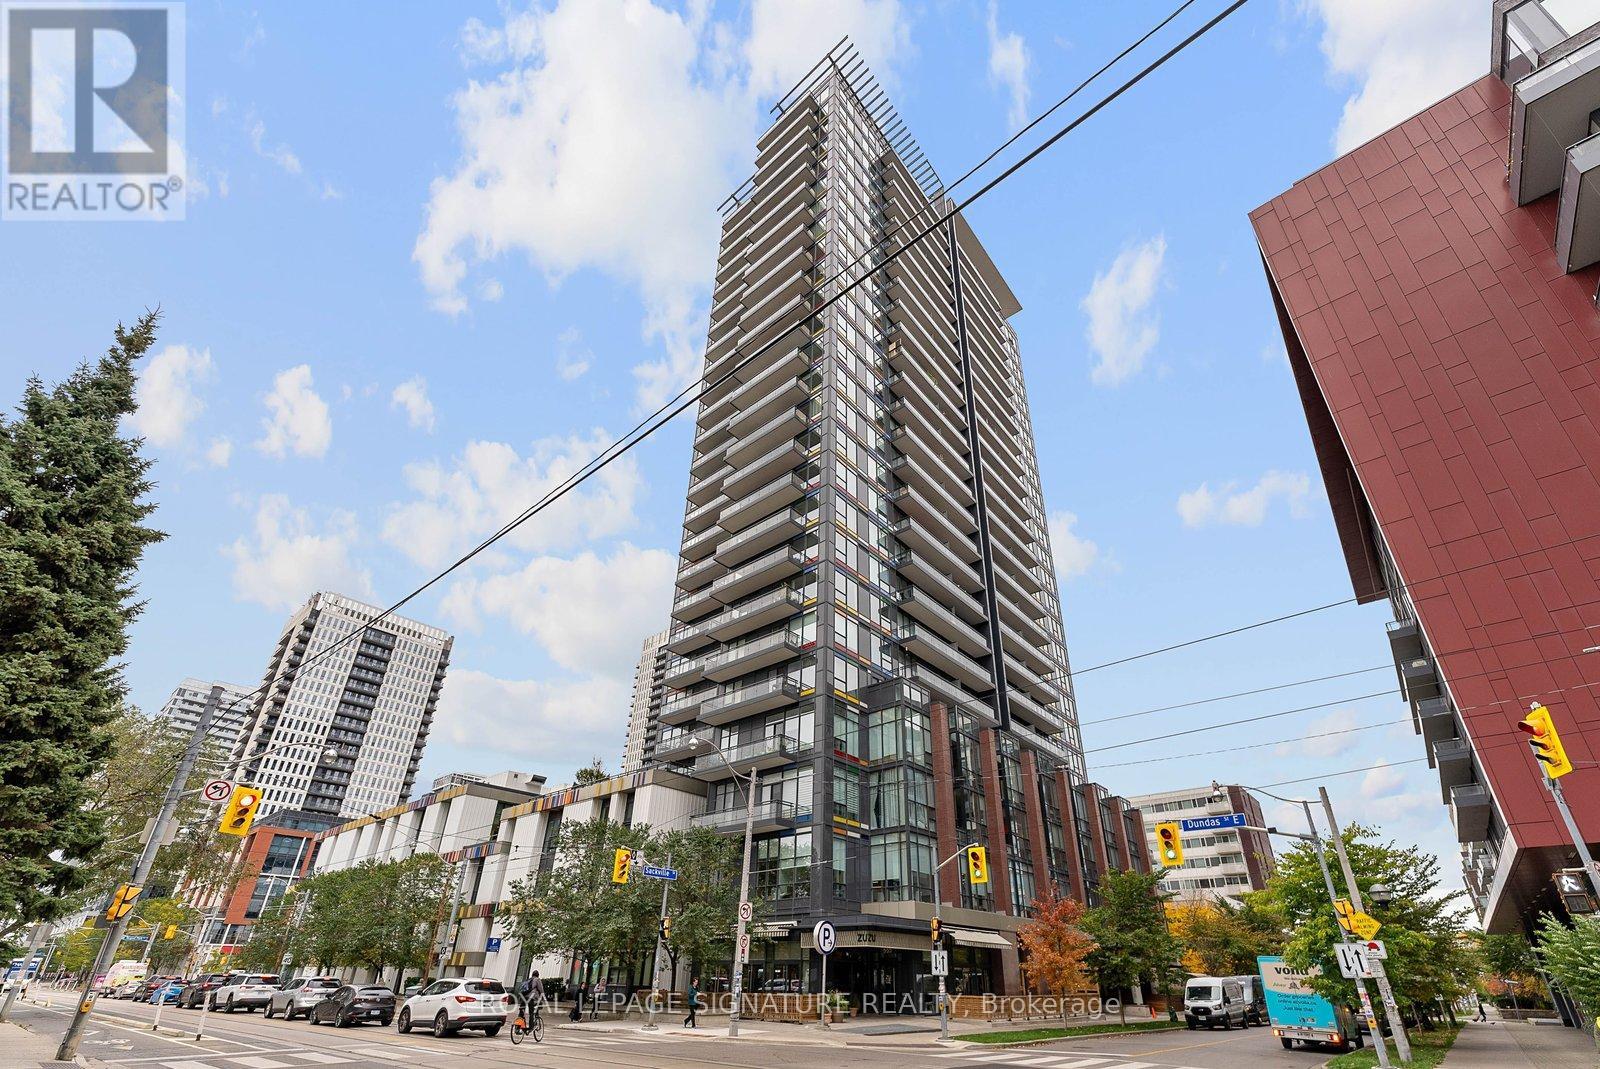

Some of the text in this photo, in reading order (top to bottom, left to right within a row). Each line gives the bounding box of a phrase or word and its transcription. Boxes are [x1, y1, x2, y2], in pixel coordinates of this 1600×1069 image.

[1187, 818, 1221, 829] Dundas
[1232, 815, 1240, 825] E
[645, 866, 670, 877] Sackville
[491, 938, 498, 946] P
[823, 928, 831, 947] P
